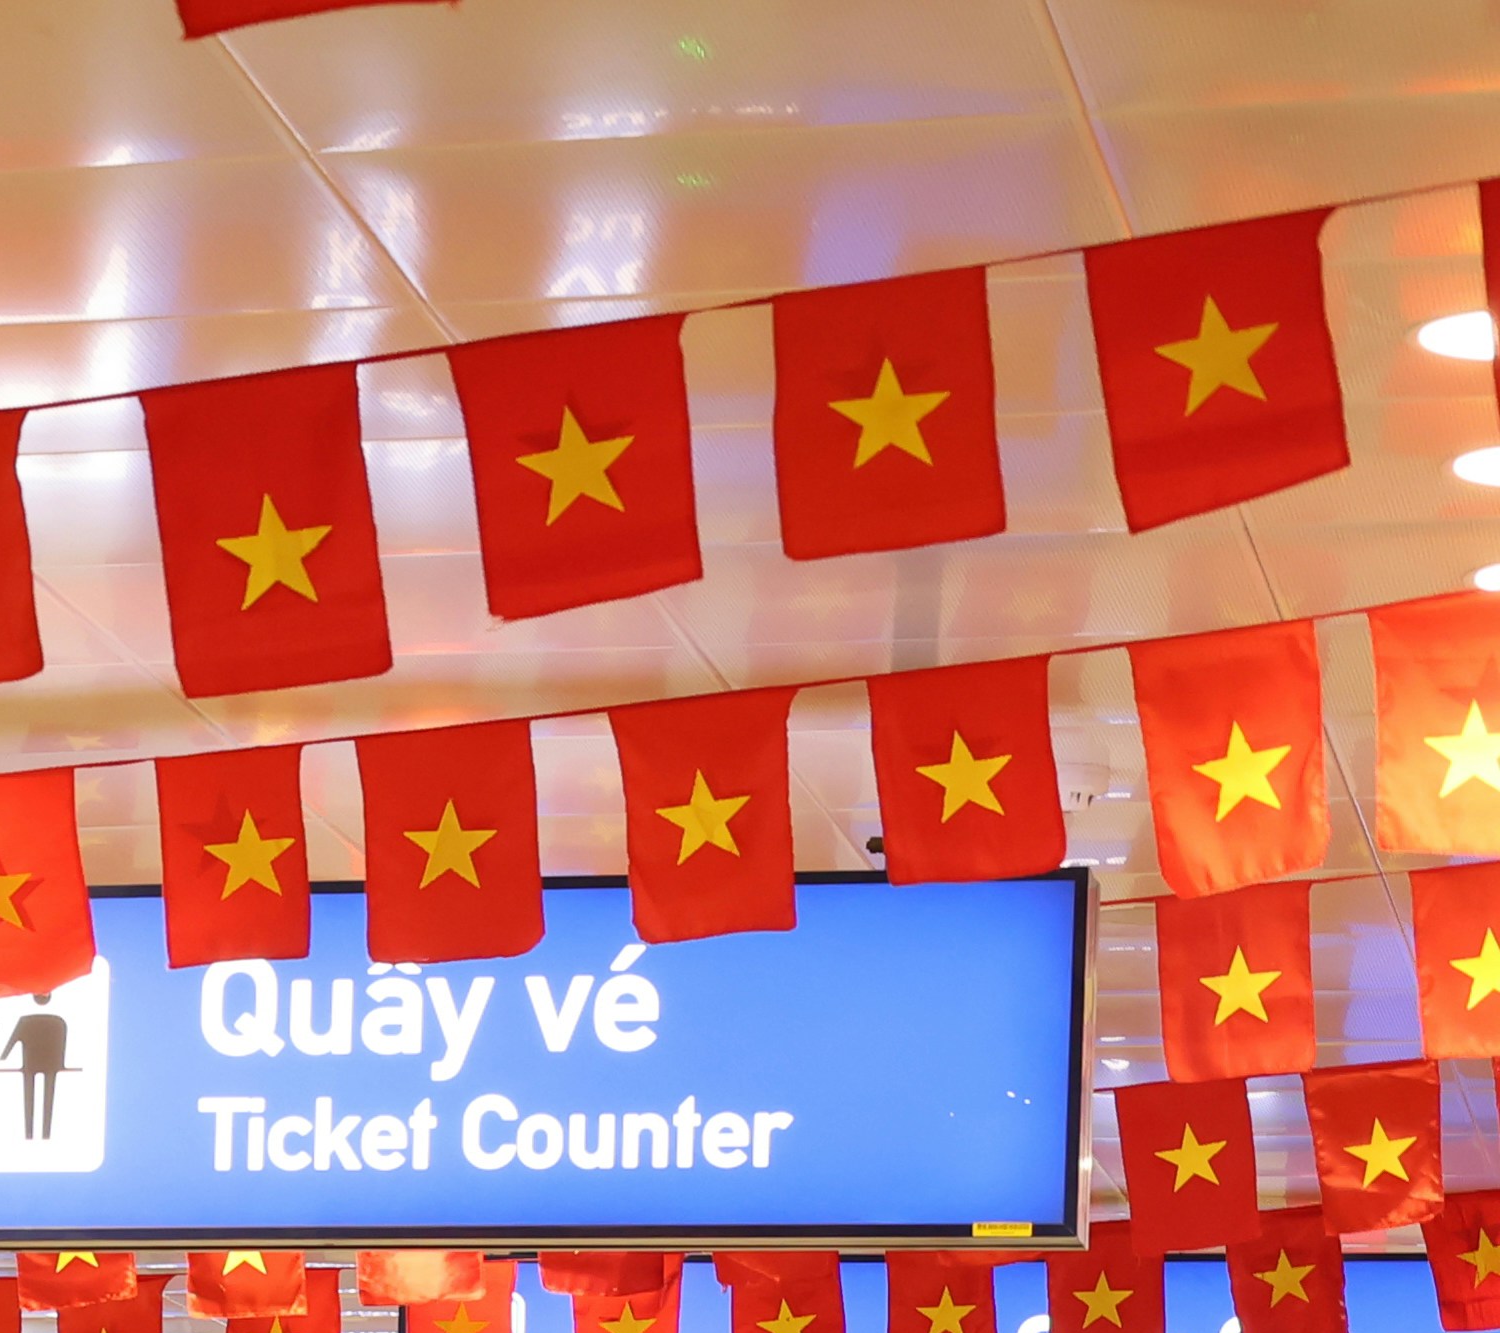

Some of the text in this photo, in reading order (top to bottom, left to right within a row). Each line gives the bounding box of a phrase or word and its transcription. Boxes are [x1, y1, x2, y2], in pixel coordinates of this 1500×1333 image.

[201, 945, 660, 1082] Quầy vé
[197, 1093, 794, 1170] Ticket Counter
